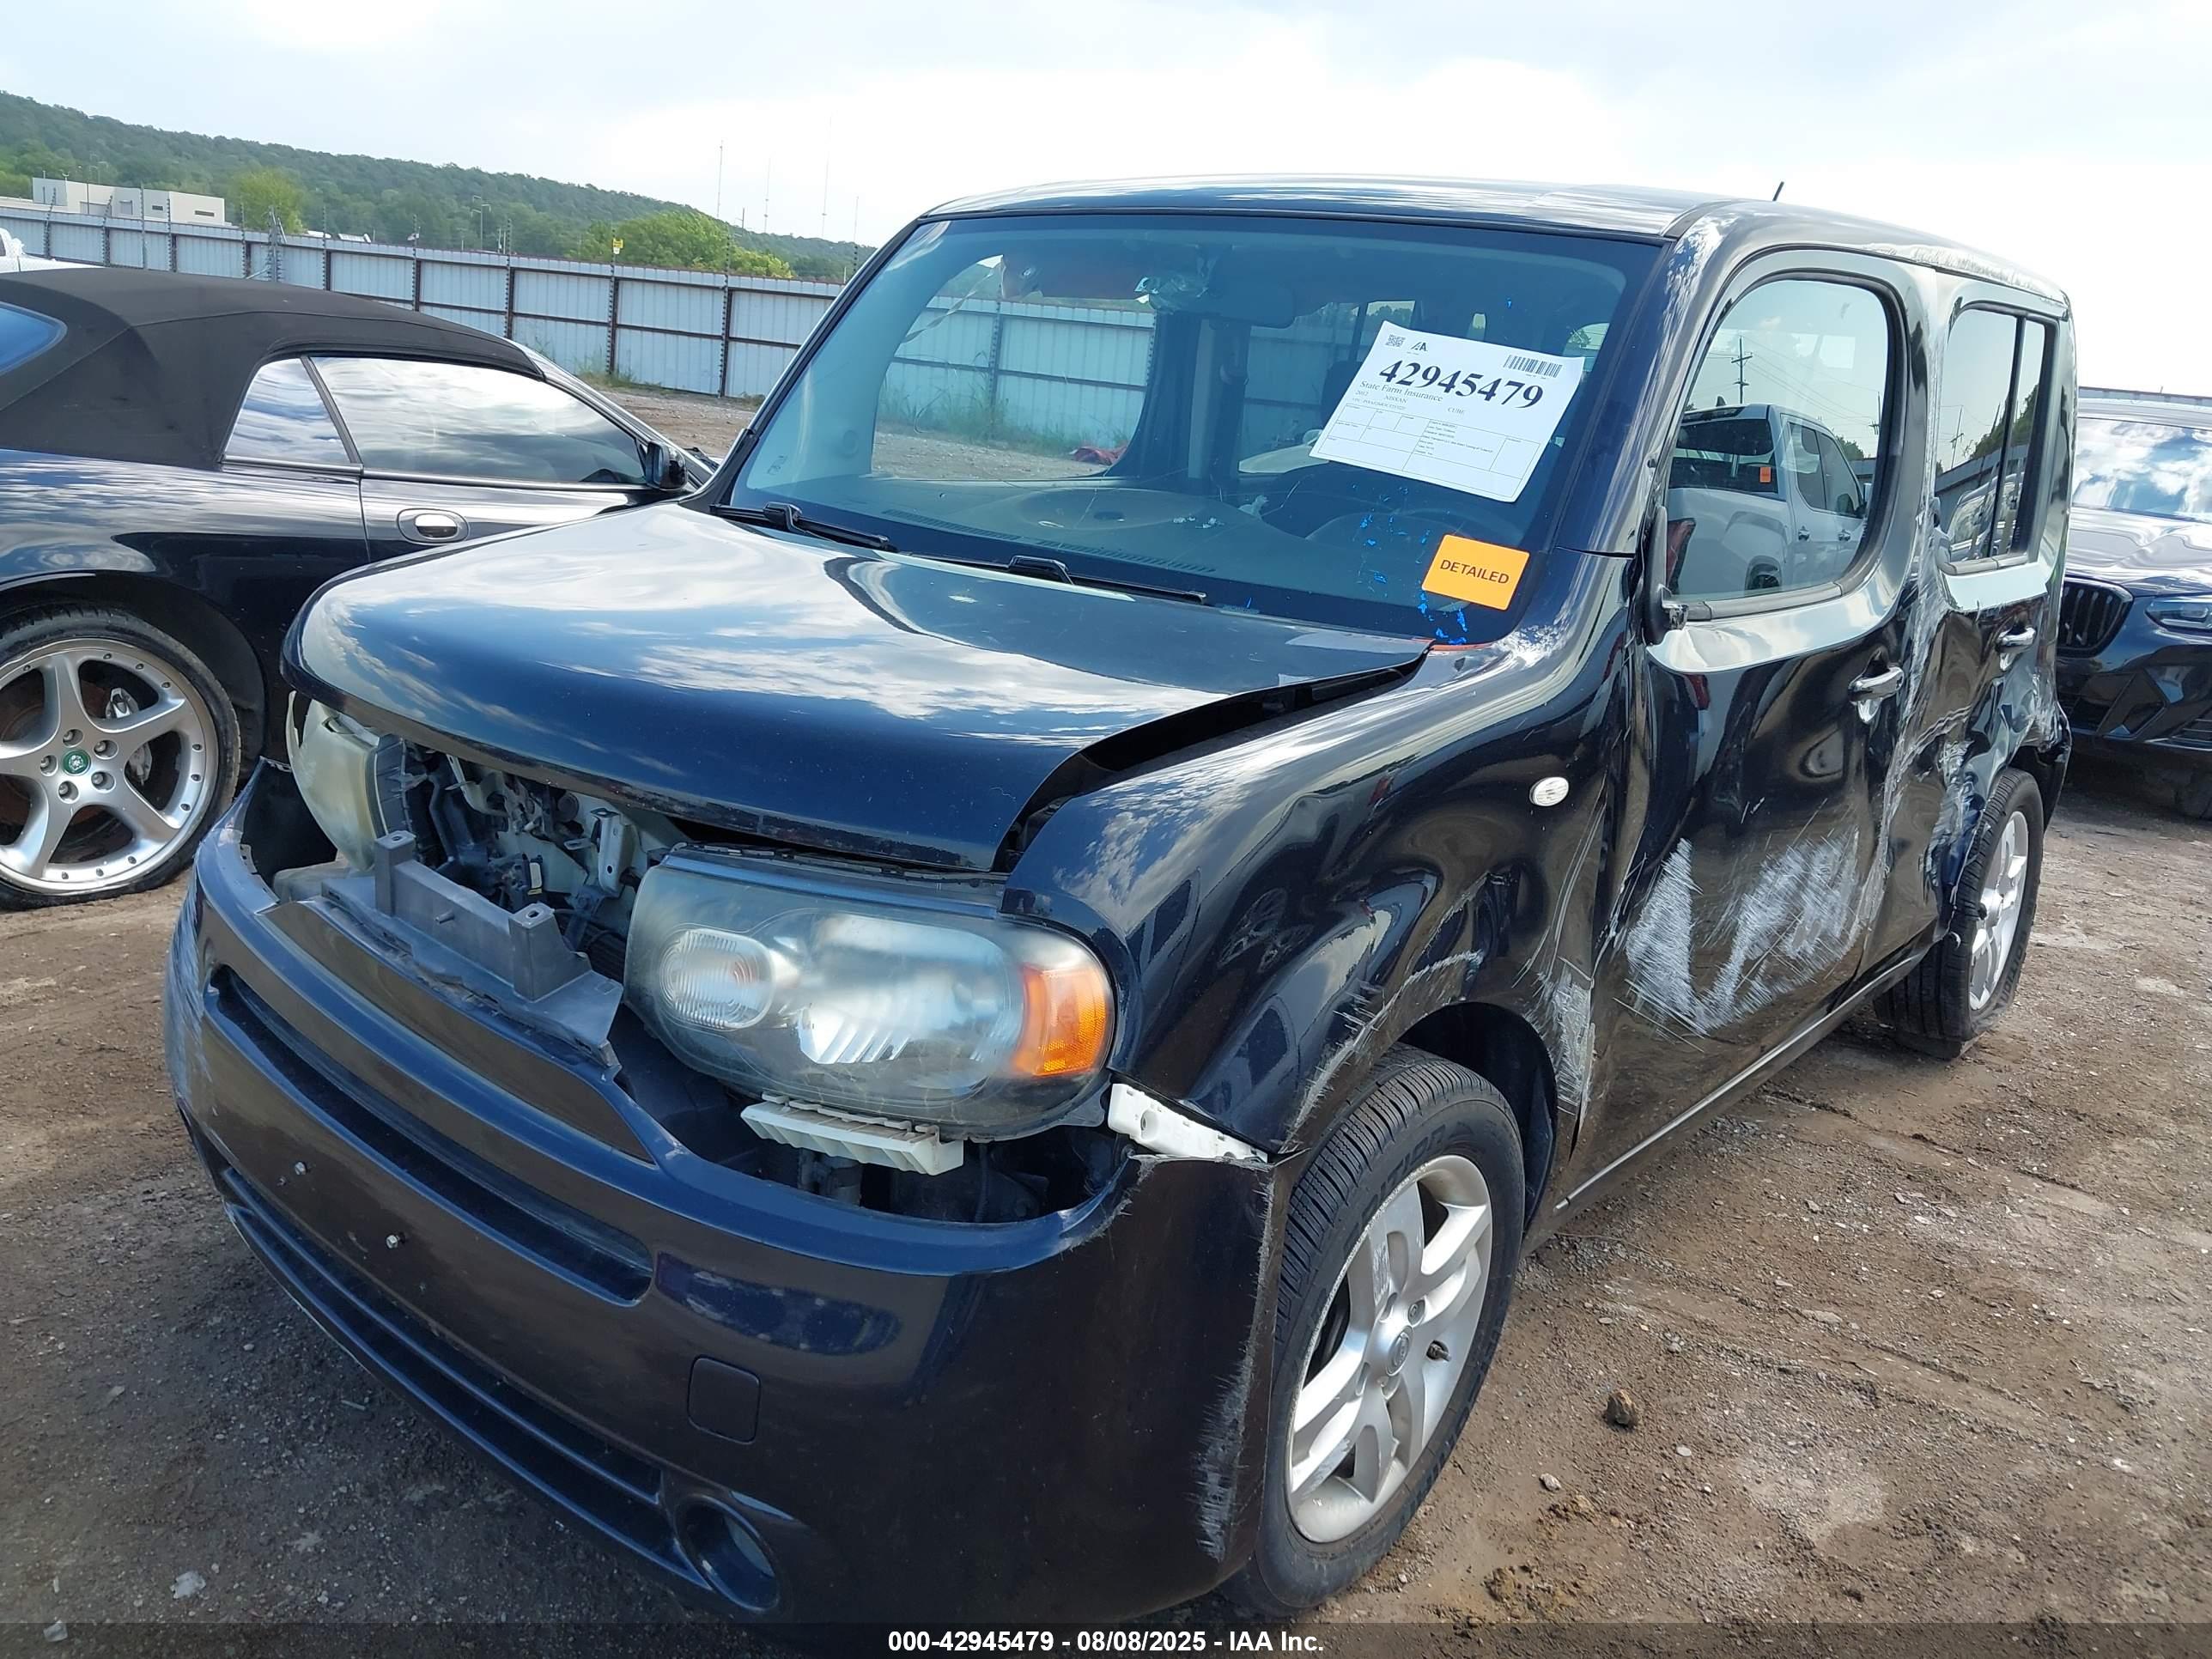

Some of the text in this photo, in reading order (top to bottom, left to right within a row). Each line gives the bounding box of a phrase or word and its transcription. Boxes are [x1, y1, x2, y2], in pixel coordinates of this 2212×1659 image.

[1359, 380, 1443, 402] State Farm Insurance
[1379, 359, 1544, 409] 42945479
[1440, 559, 1510, 584] DETAILED
